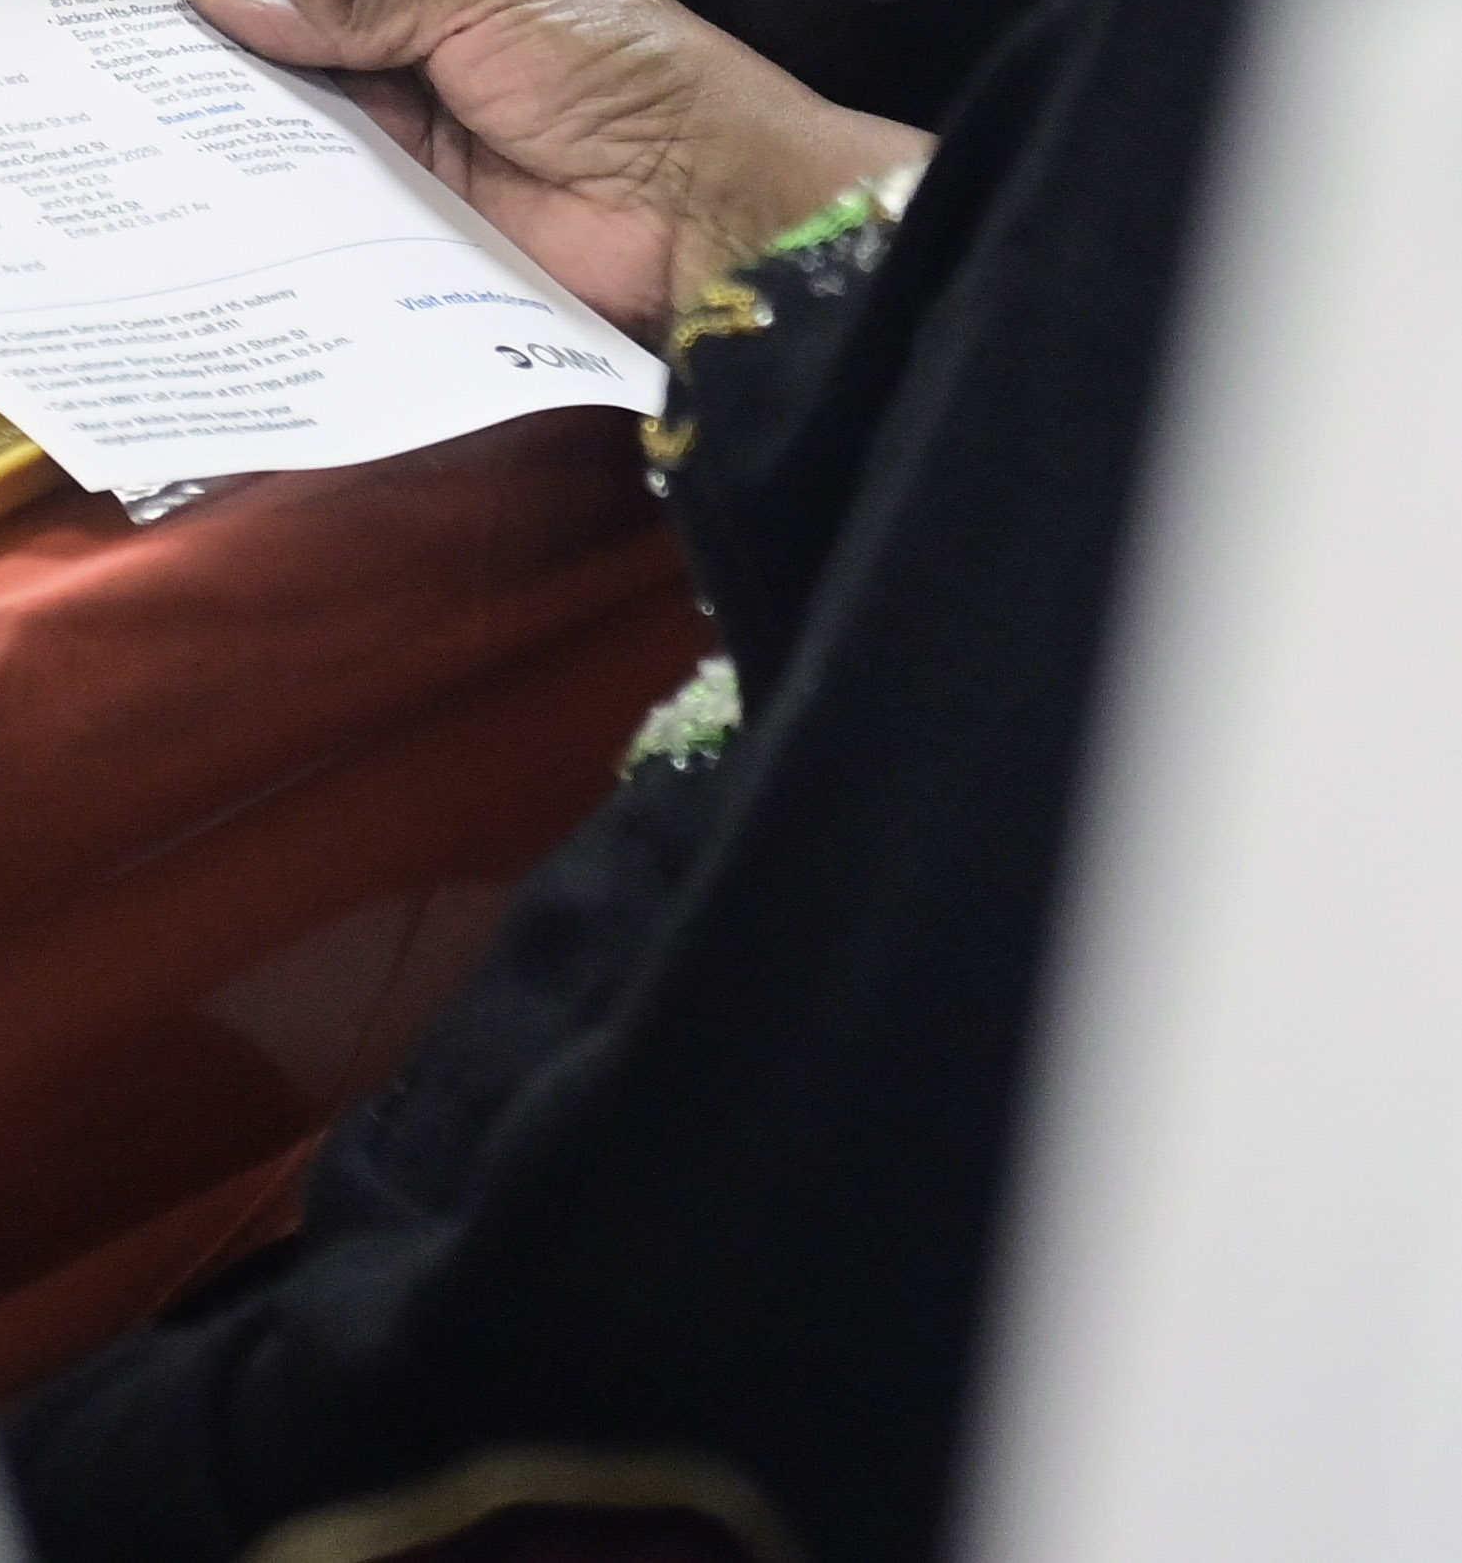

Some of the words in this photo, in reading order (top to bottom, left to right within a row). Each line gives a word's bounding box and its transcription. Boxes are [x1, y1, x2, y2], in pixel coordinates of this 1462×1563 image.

[56, 11, 107, 27] Jackson
[95, 53, 148, 70] Sutphin
[3, 72, 29, 86] and
[113, 64, 162, 82] Airport
[157, 108, 206, 126] Staten
[202, 102, 245, 116] Island
[89, 140, 109, 152] St
[244, 288, 298, 308] subway
[395, 293, 440, 311] Visit
[527, 343, 625, 381] OMNY
